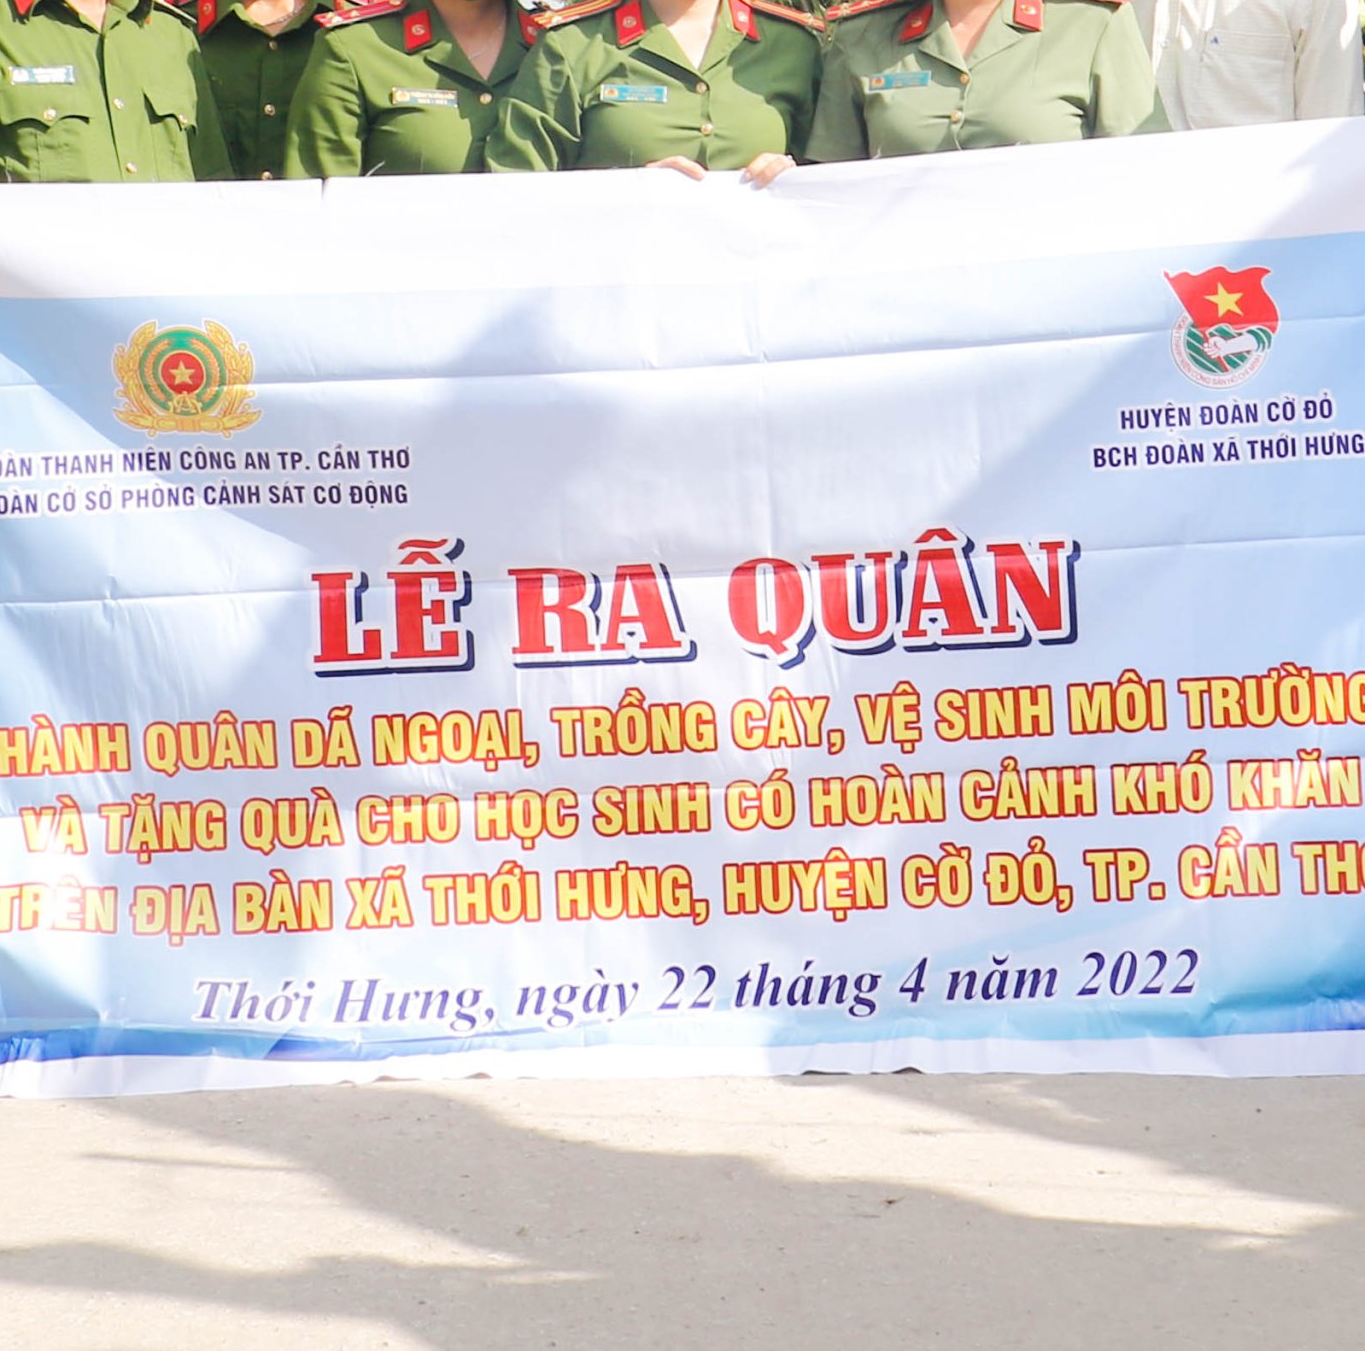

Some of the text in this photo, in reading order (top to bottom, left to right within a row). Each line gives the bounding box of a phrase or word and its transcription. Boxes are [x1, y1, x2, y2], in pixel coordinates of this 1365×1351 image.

[1093, 432, 1365, 468] BCH ĐOÀN XÃ THỚI HƯNG
[1121, 392, 1333, 434] HUYỆN ĐOÀN CỜ ĐỎ
[41, 453, 114, 476] THANH
[123, 446, 172, 472] NIÊN
[180, 445, 236, 471] CÔNG
[244, 451, 271, 470] AN
[277, 451, 311, 471] TP.
[367, 446, 411, 469] THƠ
[85, 484, 112, 511] SỞ
[121, 482, 195, 509] PHÒNG
[203, 479, 261, 506] CẢNH
[268, 481, 306, 505] SÁT
[313, 482, 342, 505] CƠ
[349, 480, 409, 509] ĐỘNG
[310, 527, 1076, 673] LỄ RA QUÂN
[143, 710, 278, 777] QUÂN
[290, 705, 361, 769] DÃ
[372, 708, 541, 772] NGOẠI,
[551, 687, 718, 757] TRỒNG
[730, 686, 846, 754] CÂY,
[854, 681, 923, 753] VỆ
[935, 684, 1054, 742] SINH
[1067, 668, 1167, 735] MÔI
[19, 748, 1362, 864] VÀ TẶNG QUÀ CHO HỌC SINH CÓ HOÀN CẢNH KHÓ KHĂN
[130, 880, 221, 947] ĐỊA
[234, 868, 333, 933] BÀN
[345, 864, 415, 930] XÃ
[422, 860, 541, 927] THỚI
[554, 862, 710, 925] HƯNG,
[722, 847, 887, 922] HUYỆN
[901, 843, 973, 910] CỜ
[984, 836, 1073, 913] ĐỎ,
[1083, 848, 1166, 902] TP.
[1177, 826, 1280, 900] CẦN
[193, 947, 1200, 1032] Thới Hưng, ngày 22 tháng 4 năm 2022
